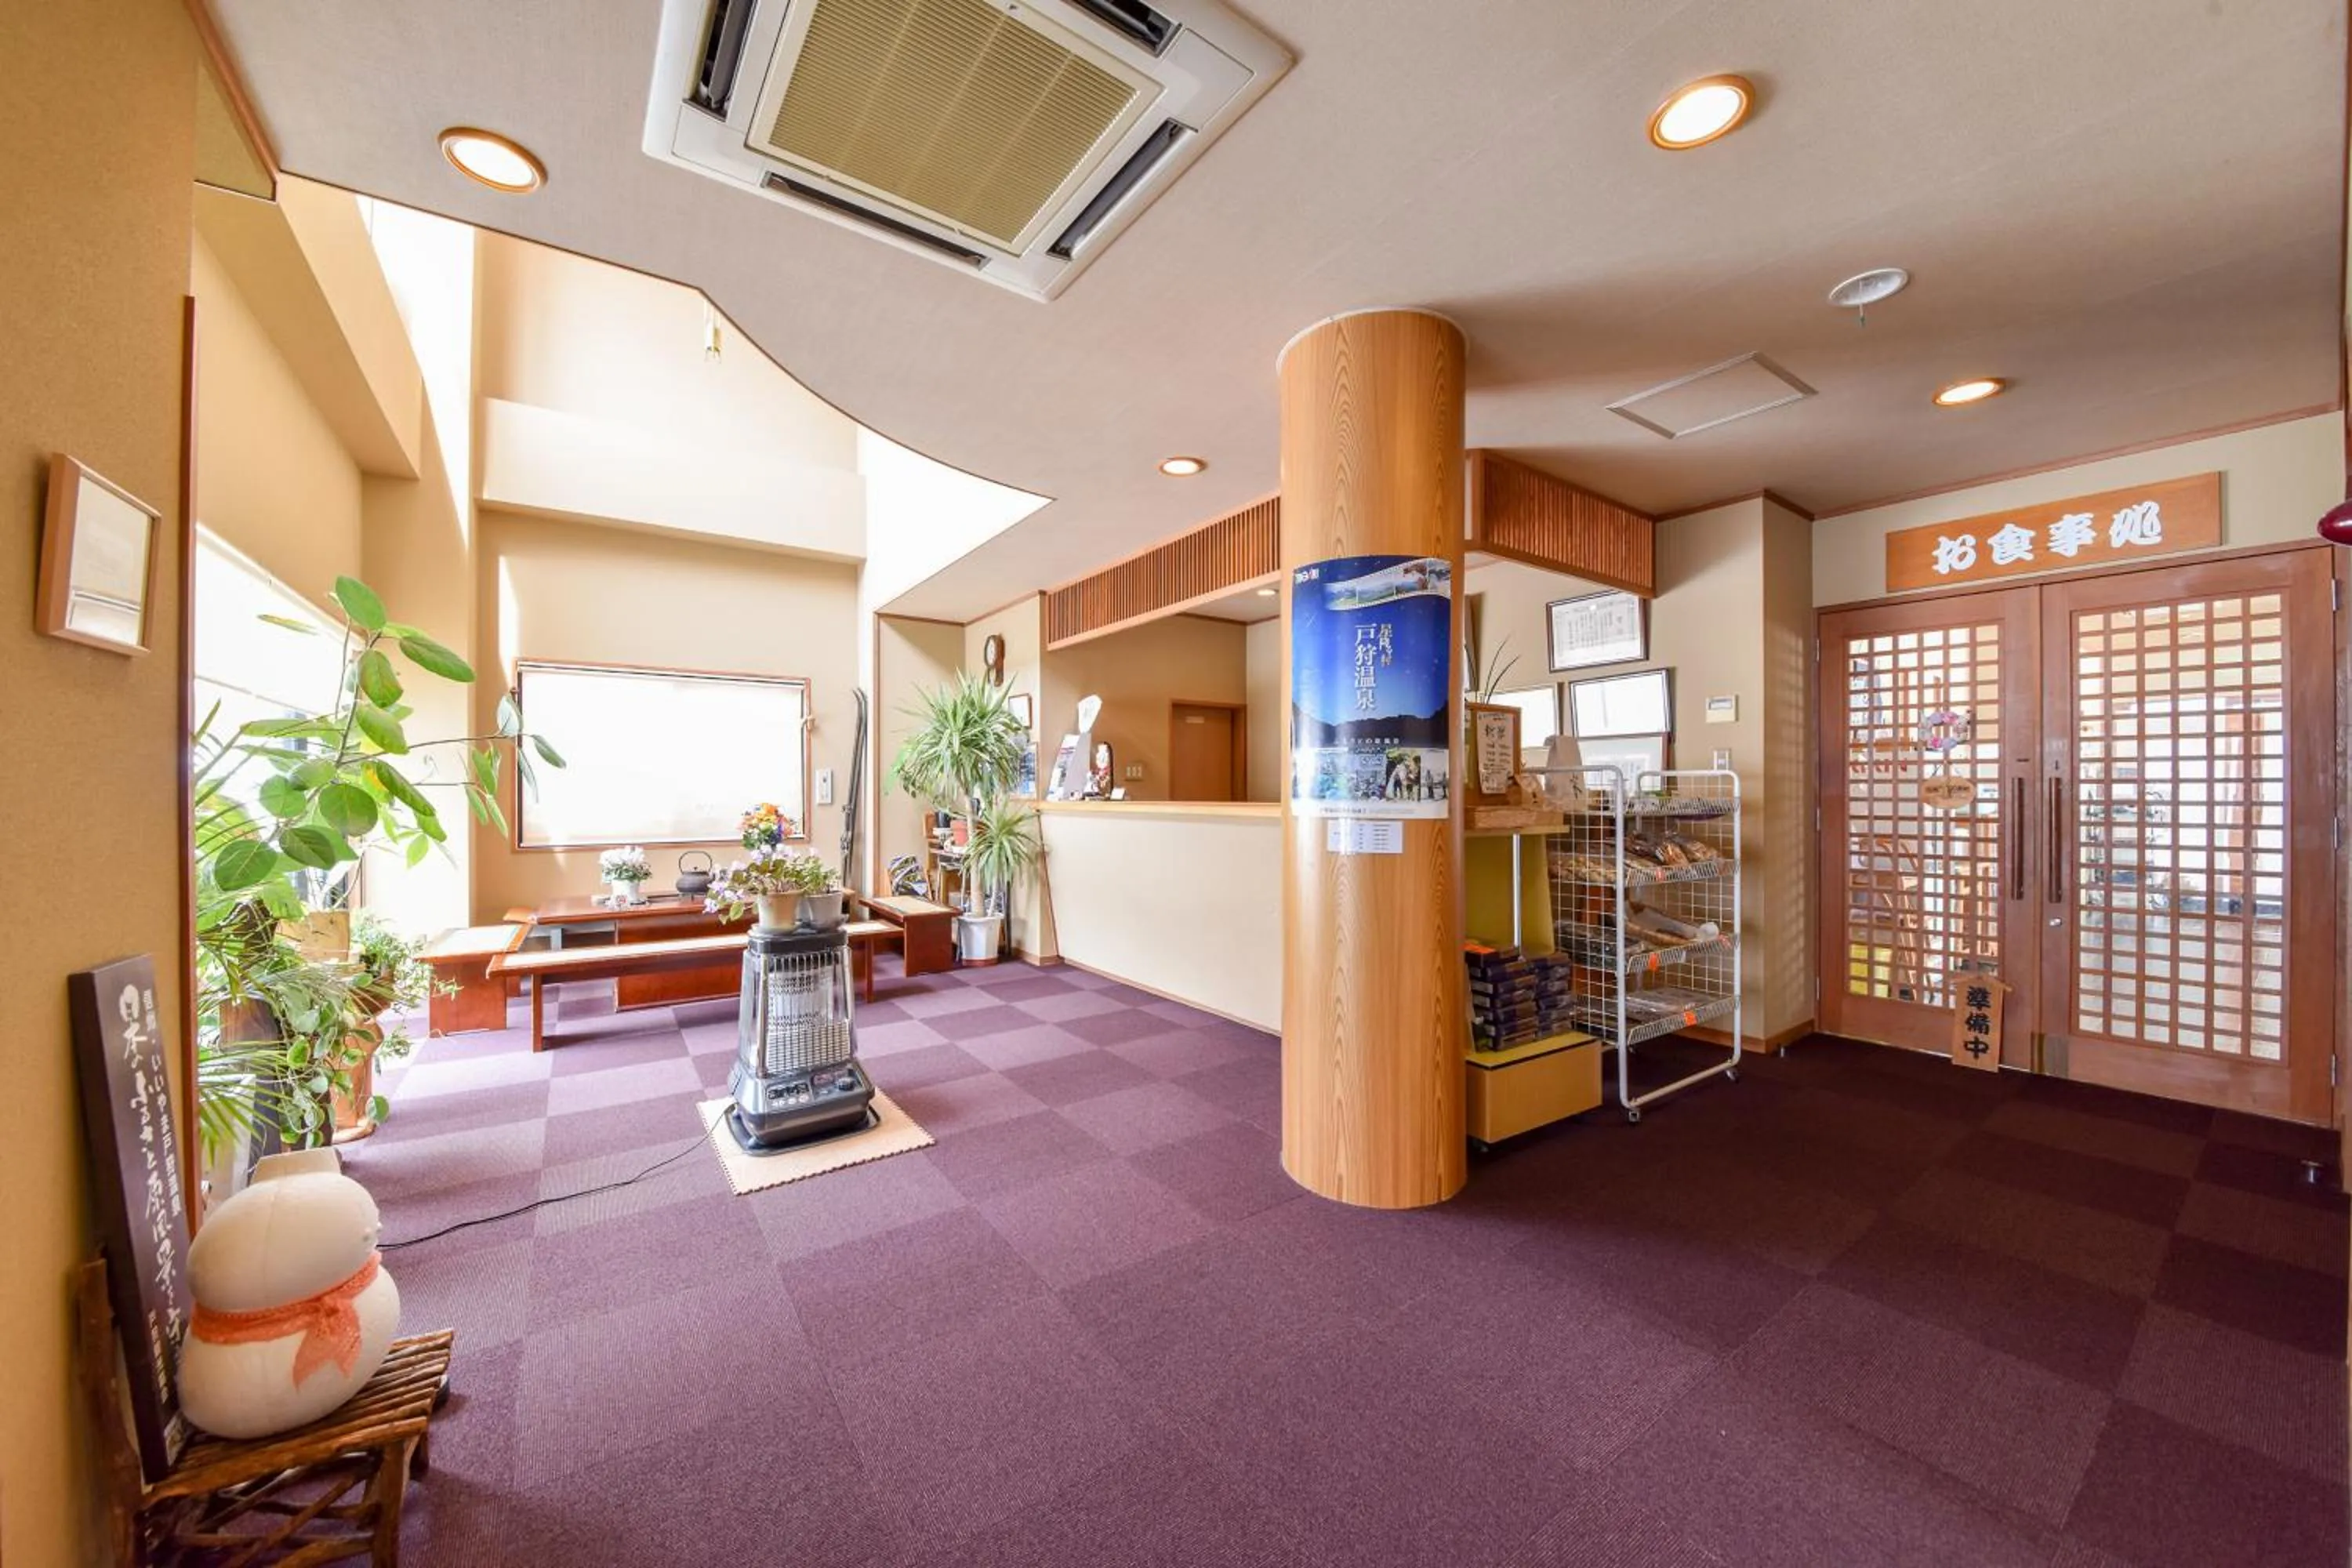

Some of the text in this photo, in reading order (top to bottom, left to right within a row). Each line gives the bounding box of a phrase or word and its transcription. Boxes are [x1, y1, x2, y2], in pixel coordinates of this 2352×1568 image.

[1932, 500, 2161, 574] お食事処
[1354, 622, 1377, 710] 戸狩温泉
[1965, 985, 1991, 1060] 準備中
